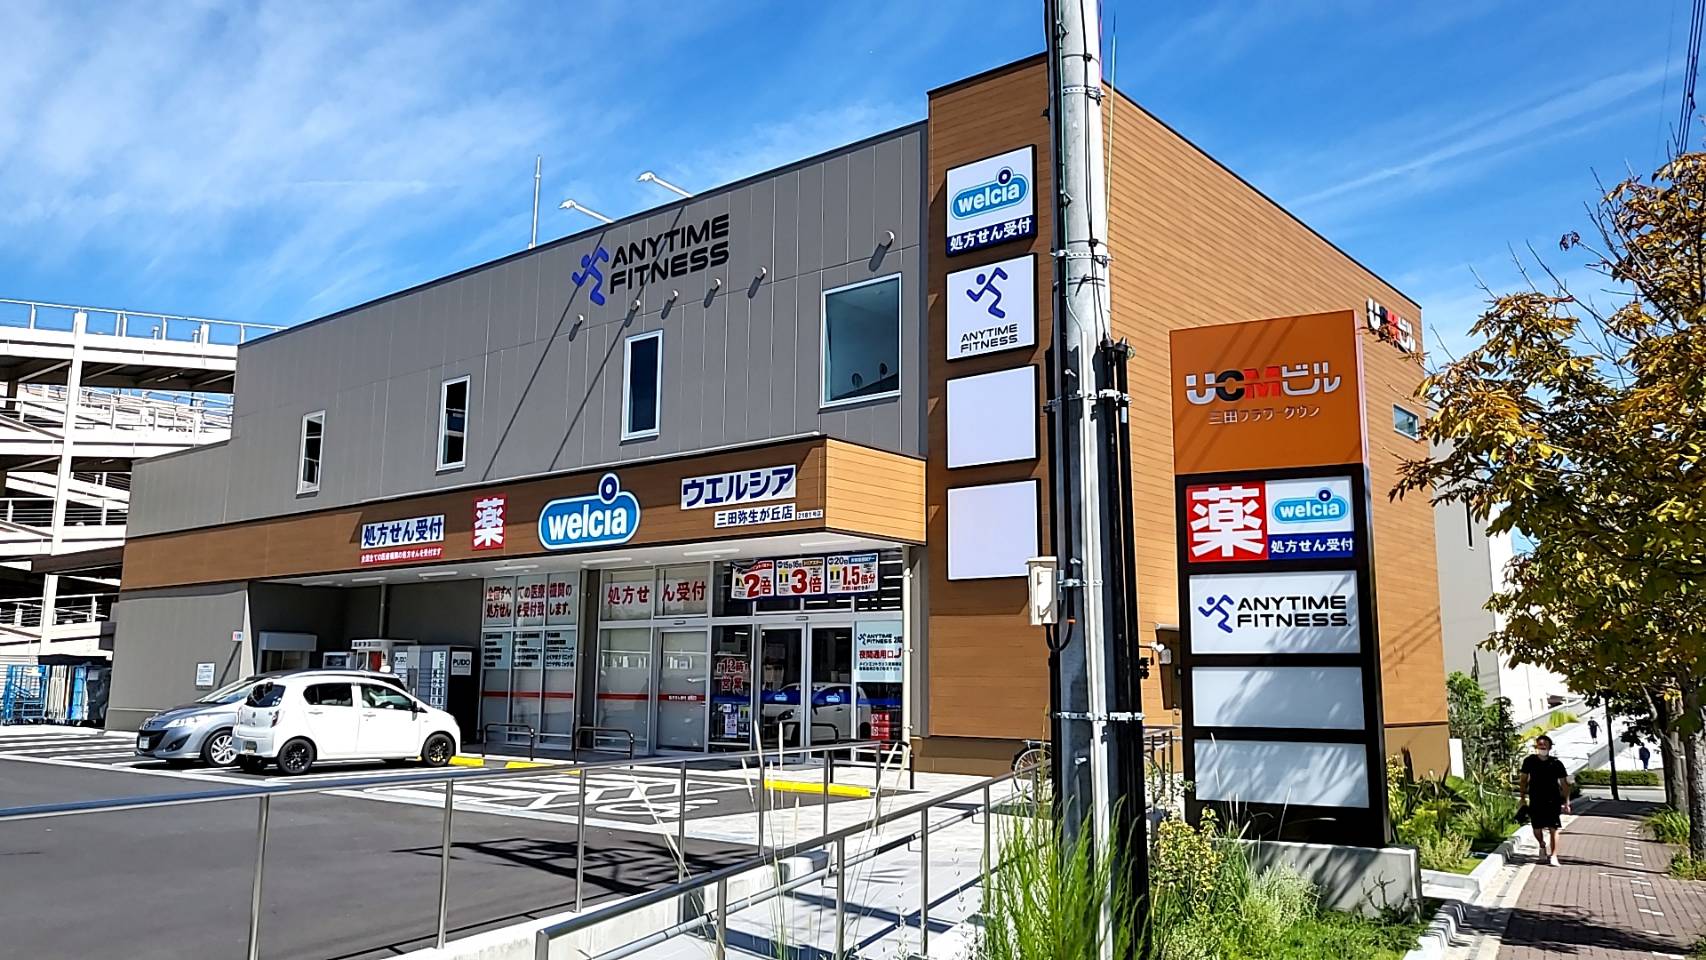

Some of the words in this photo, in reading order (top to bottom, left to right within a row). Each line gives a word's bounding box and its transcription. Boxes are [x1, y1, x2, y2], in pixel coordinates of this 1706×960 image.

[958, 185, 1020, 214] welcia
[611, 213, 729, 269] ANYTIME
[950, 217, 1032, 251] 処方せん受付
[609, 241, 729, 294] FITNESS
[960, 333, 1018, 353] FITNESS
[961, 323, 1018, 343] ANYTIME
[1185, 361, 1342, 406] UCMビル
[683, 467, 794, 507] ウエルシア
[473, 498, 505, 547] 薬
[547, 502, 628, 541] welcia
[716, 505, 794, 526] 三田弥生が丘店
[1190, 486, 1266, 558] 薬
[1279, 499, 1341, 519] welcia
[363, 517, 443, 547] 処方せん受付
[1270, 537, 1355, 554] 処方せん受付
[606, 580, 706, 605] 処方せん受付
[1237, 594, 1347, 611] ANYTIME
[1237, 612, 1349, 628] FITNESS
[453, 658, 471, 666] PUDO
